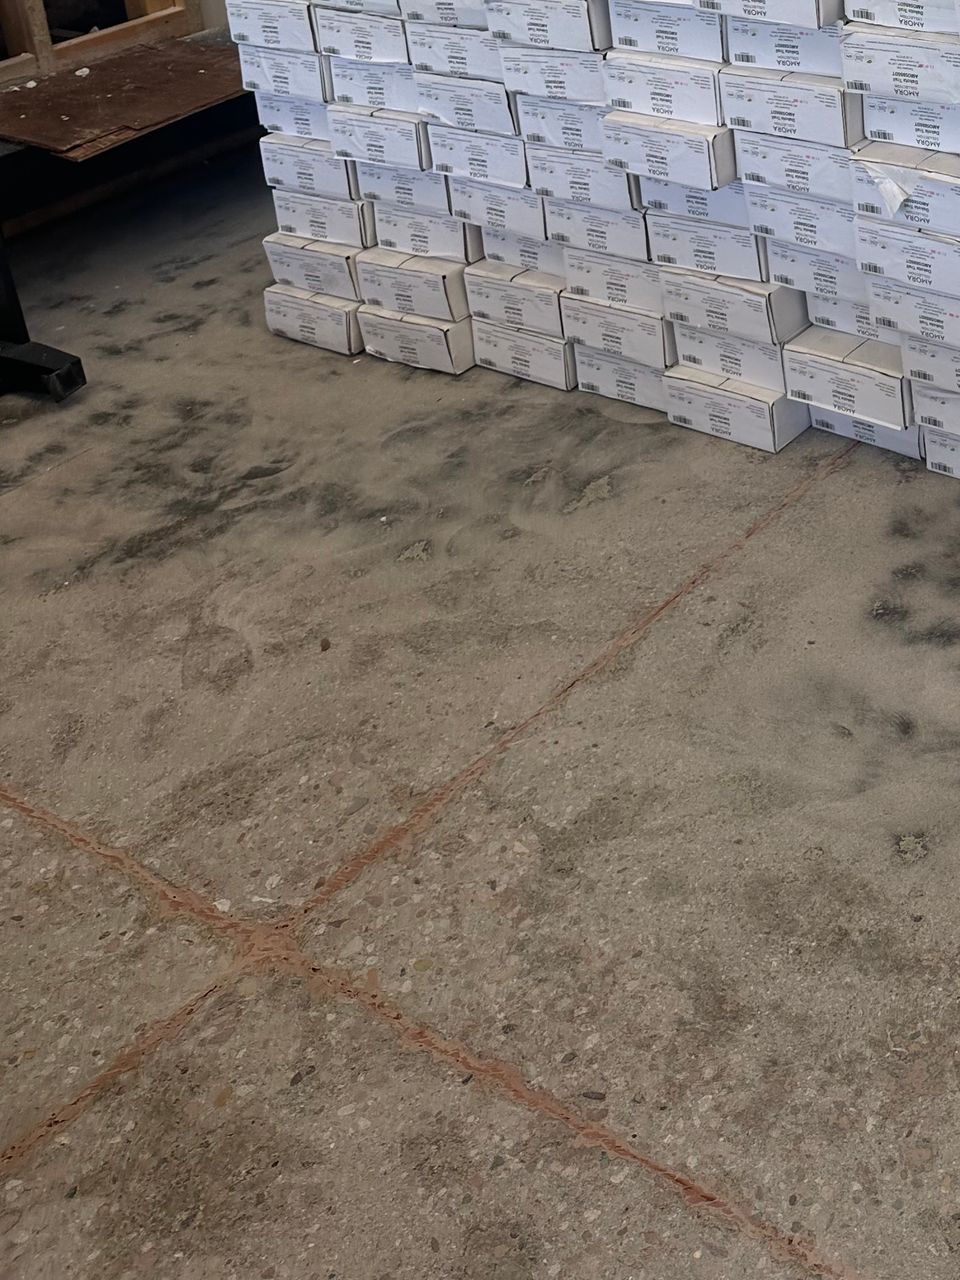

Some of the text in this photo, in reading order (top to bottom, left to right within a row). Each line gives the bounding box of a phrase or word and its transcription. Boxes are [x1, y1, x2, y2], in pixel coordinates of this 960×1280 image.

[742, 8, 767, 17] AMORA
[894, 88, 919, 97] AMORA
[773, 125, 796, 134] AMORA
[907, 274, 932, 285] AMORA
[833, 403, 855, 414] AMORA
